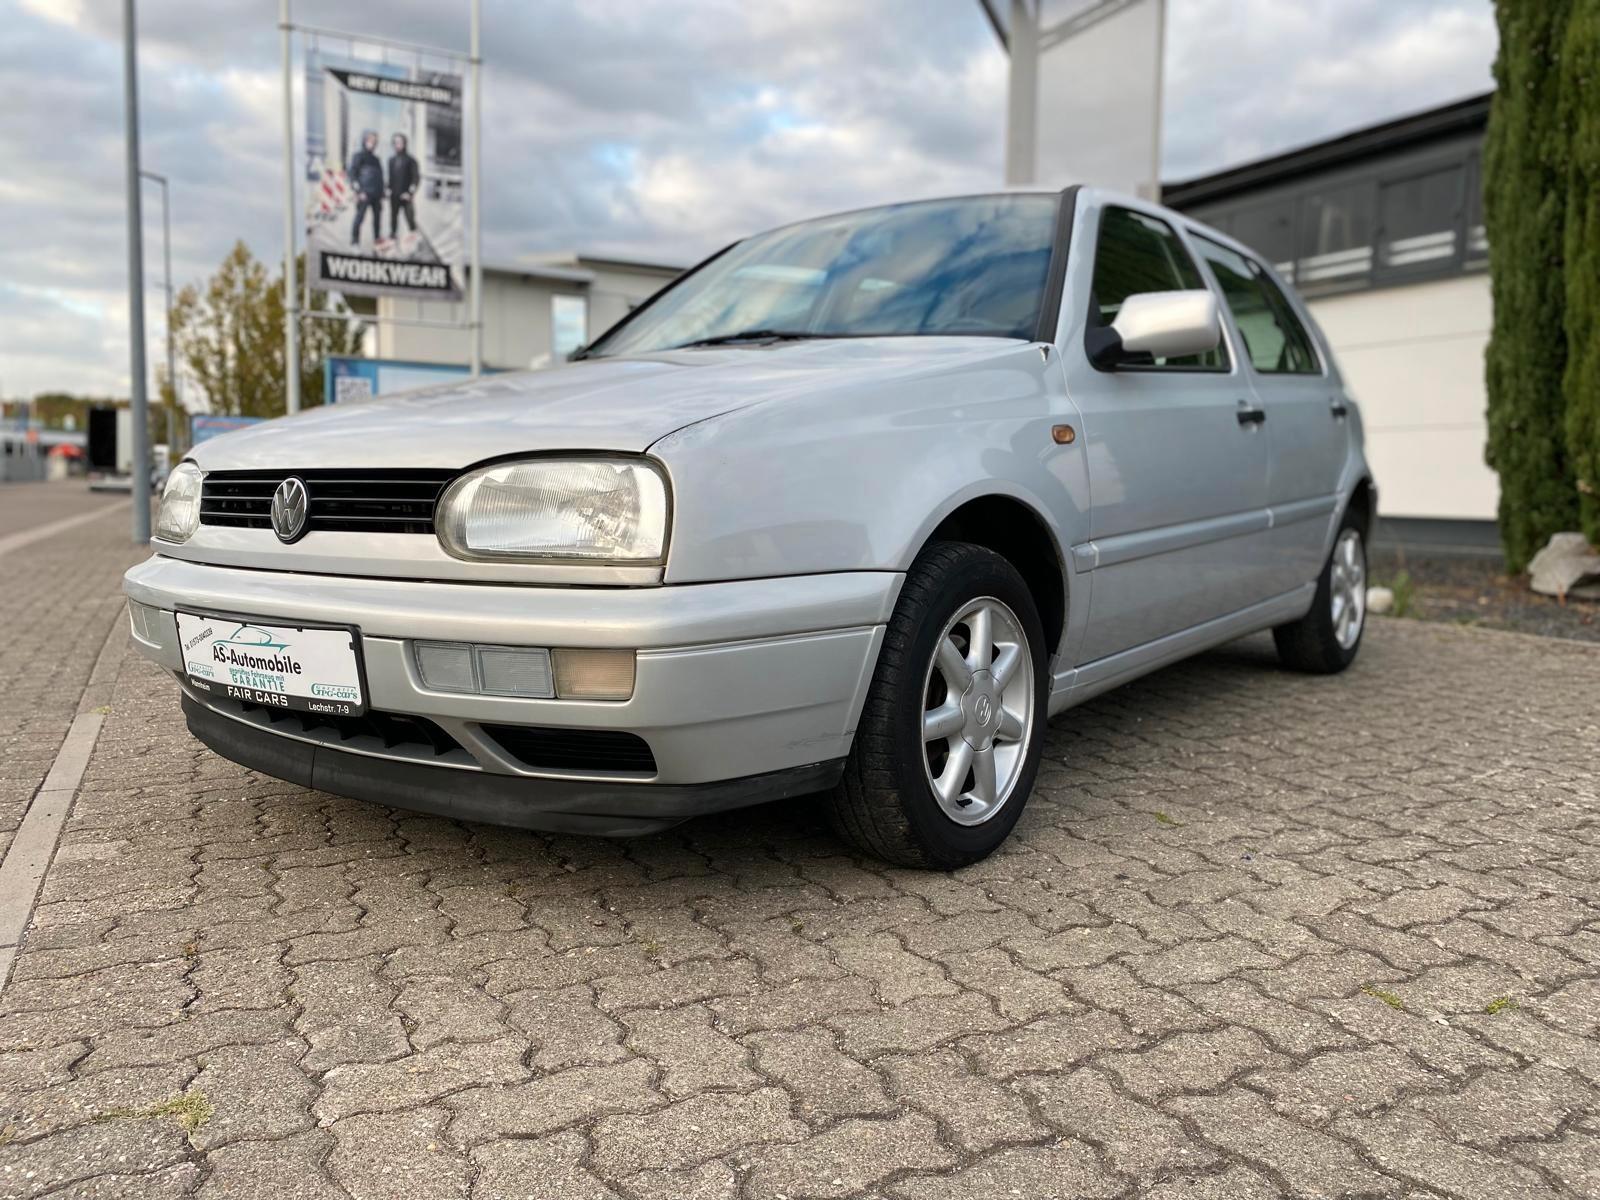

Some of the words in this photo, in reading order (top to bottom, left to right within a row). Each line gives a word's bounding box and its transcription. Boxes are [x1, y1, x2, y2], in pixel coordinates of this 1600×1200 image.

[347, 74, 378, 92] NEW
[378, 79, 452, 103] COLLECTION
[326, 255, 446, 288] WORKWEAR
[213, 645, 302, 675] AS-Automobile
[232, 673, 285, 692] GARANTIE
[251, 670, 275, 681] Fahrzeug
[227, 686, 252, 700] FAIR
[255, 691, 288, 707] CARS
[308, 701, 336, 713] Lechstr.
[336, 704, 350, 714] 7-9
